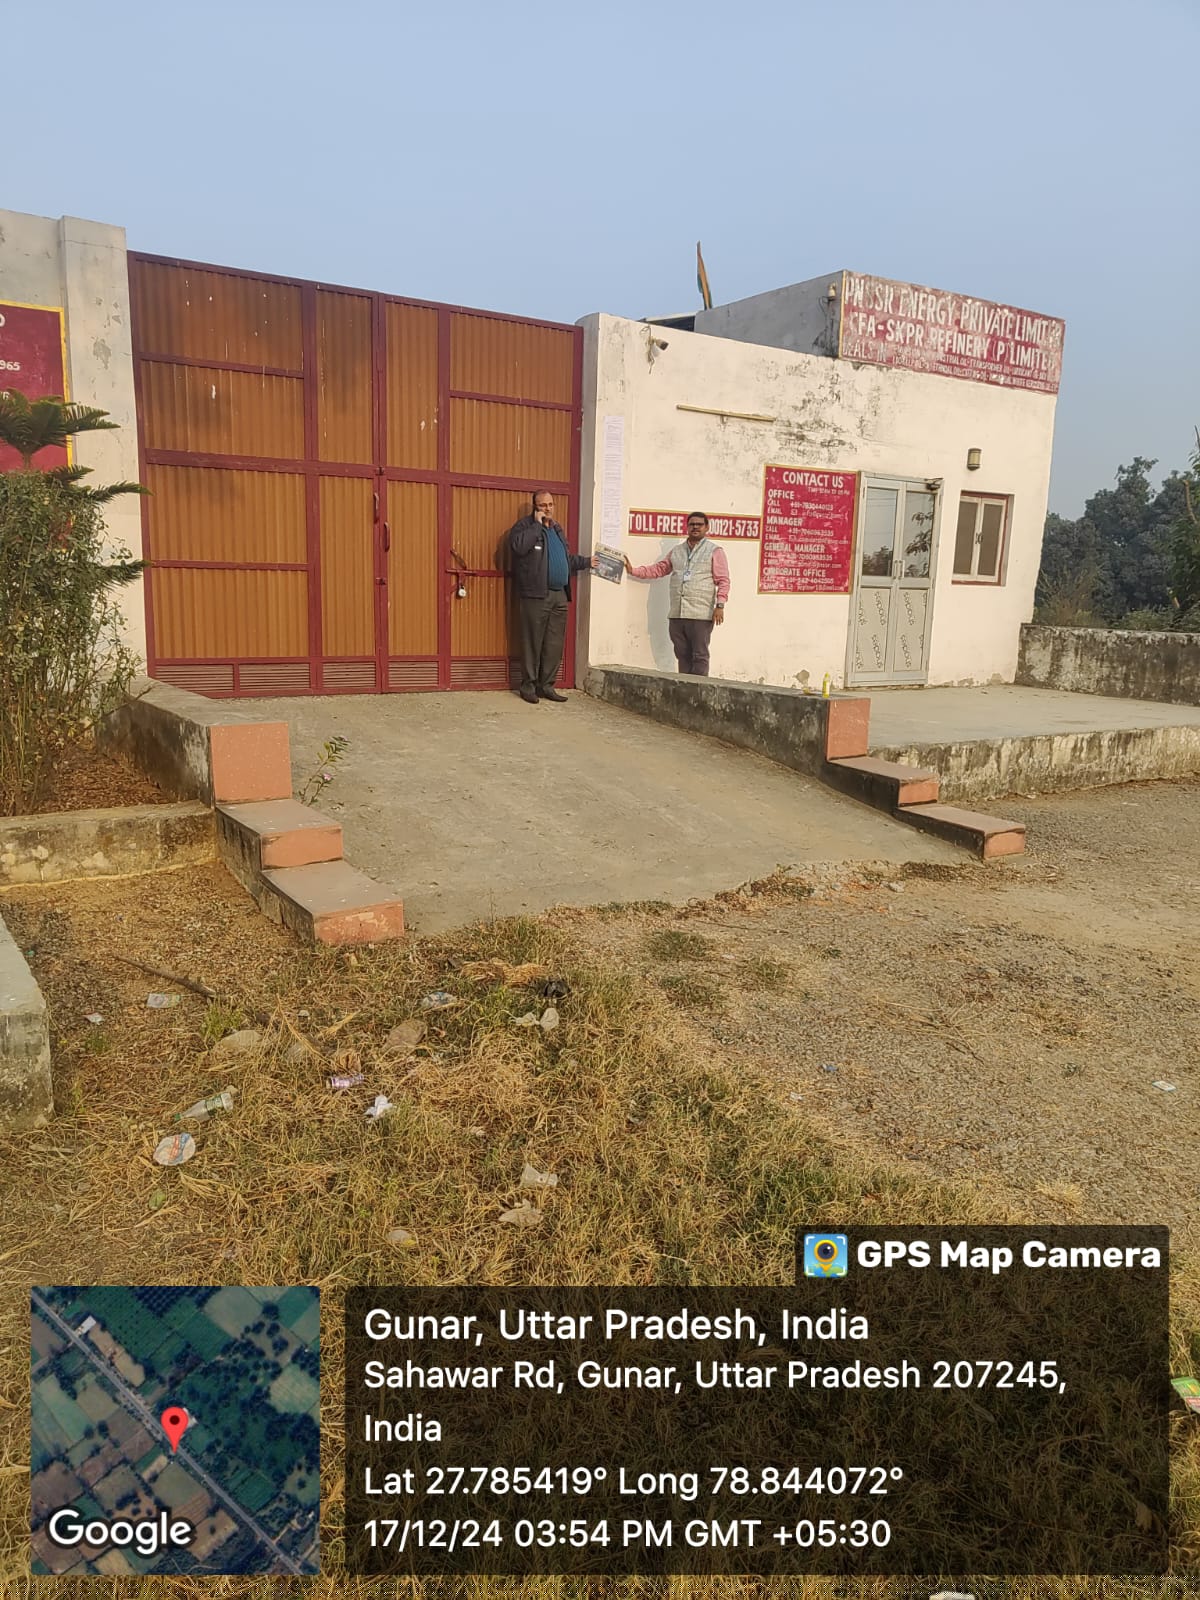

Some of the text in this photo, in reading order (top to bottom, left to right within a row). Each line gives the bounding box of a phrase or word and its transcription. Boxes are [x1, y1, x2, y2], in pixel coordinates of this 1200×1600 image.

[899, 286, 957, 325] ENERGY
[961, 303, 1014, 340] PRIVATE
[1015, 313, 1062, 348] LIMIT
[929, 328, 990, 359] REFINERY
[783, 472, 843, 488] CONTACT US
[768, 489, 794, 499] OFFICE
[629, 514, 654, 531] TOLL
[657, 515, 683, 533] FREE
[767, 516, 803, 526] MANAGER
[764, 542, 825, 553] GENERAL MANAGER
[803, 569, 826, 577] OFFICE
